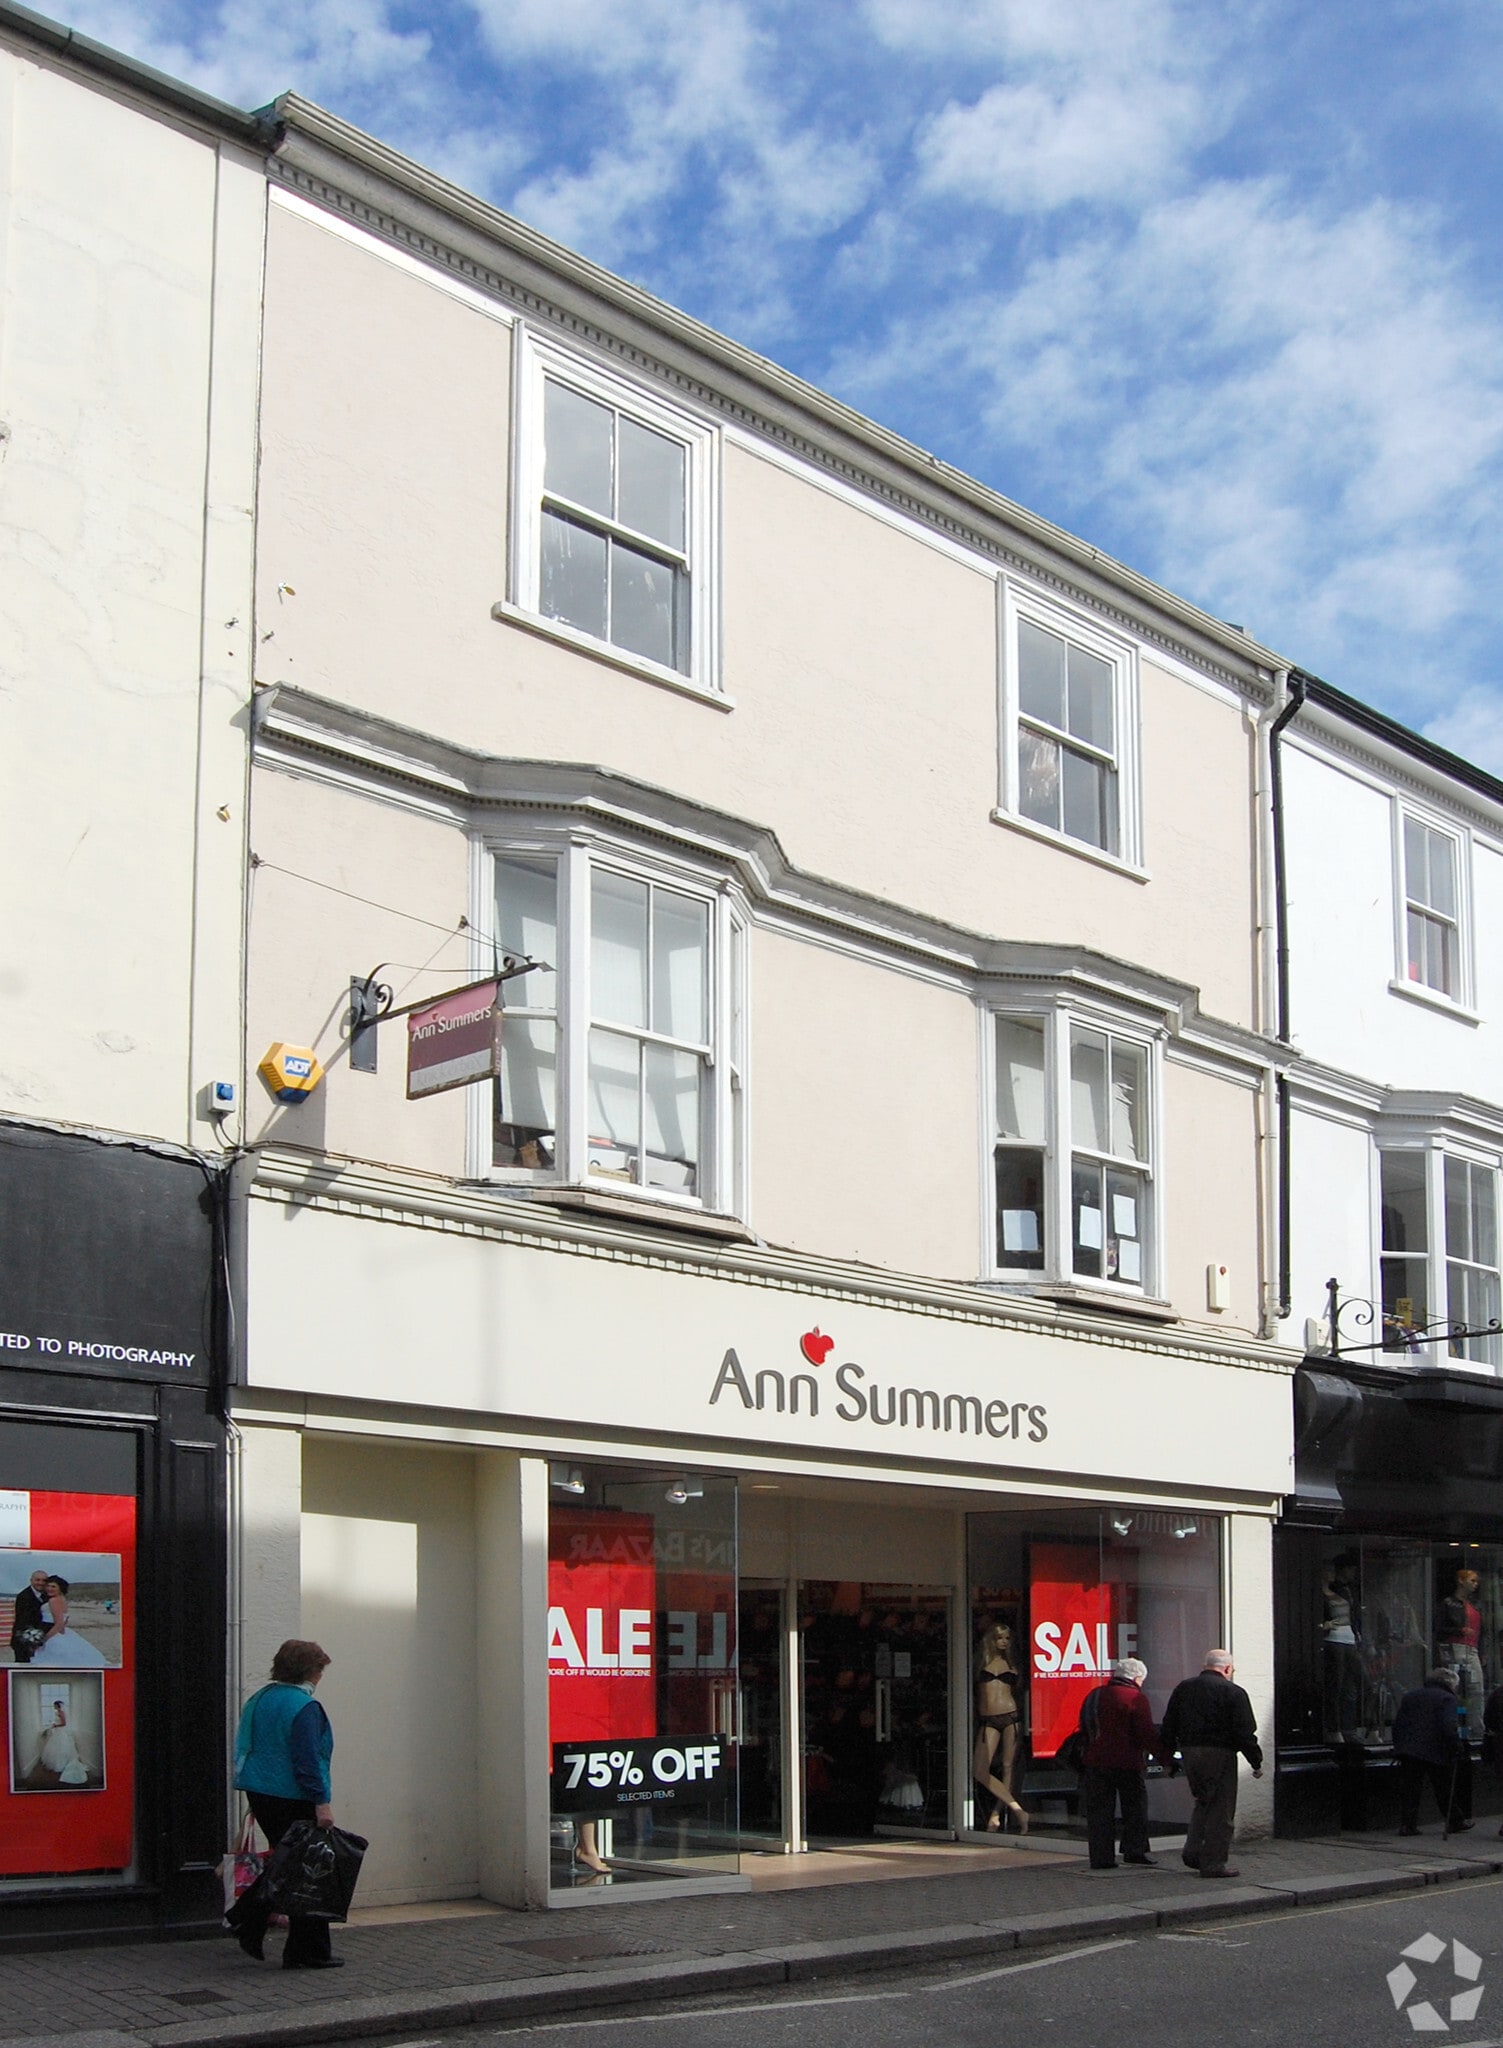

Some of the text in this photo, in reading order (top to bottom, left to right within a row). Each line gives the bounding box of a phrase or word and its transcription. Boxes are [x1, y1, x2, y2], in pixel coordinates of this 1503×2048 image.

[412, 1006, 492, 1042] Ann Summers
[285, 1059, 310, 1075] ADT
[37, 1337, 61, 1353] TO
[68, 1341, 196, 1367] PHOTOGRAPHY
[709, 1348, 1048, 1442] Ann Summers
[1034, 1621, 1138, 1672] SALE
[563, 1746, 721, 1789] 75% OFF
[617, 1789, 675, 1801] SELECTED ITEMS
